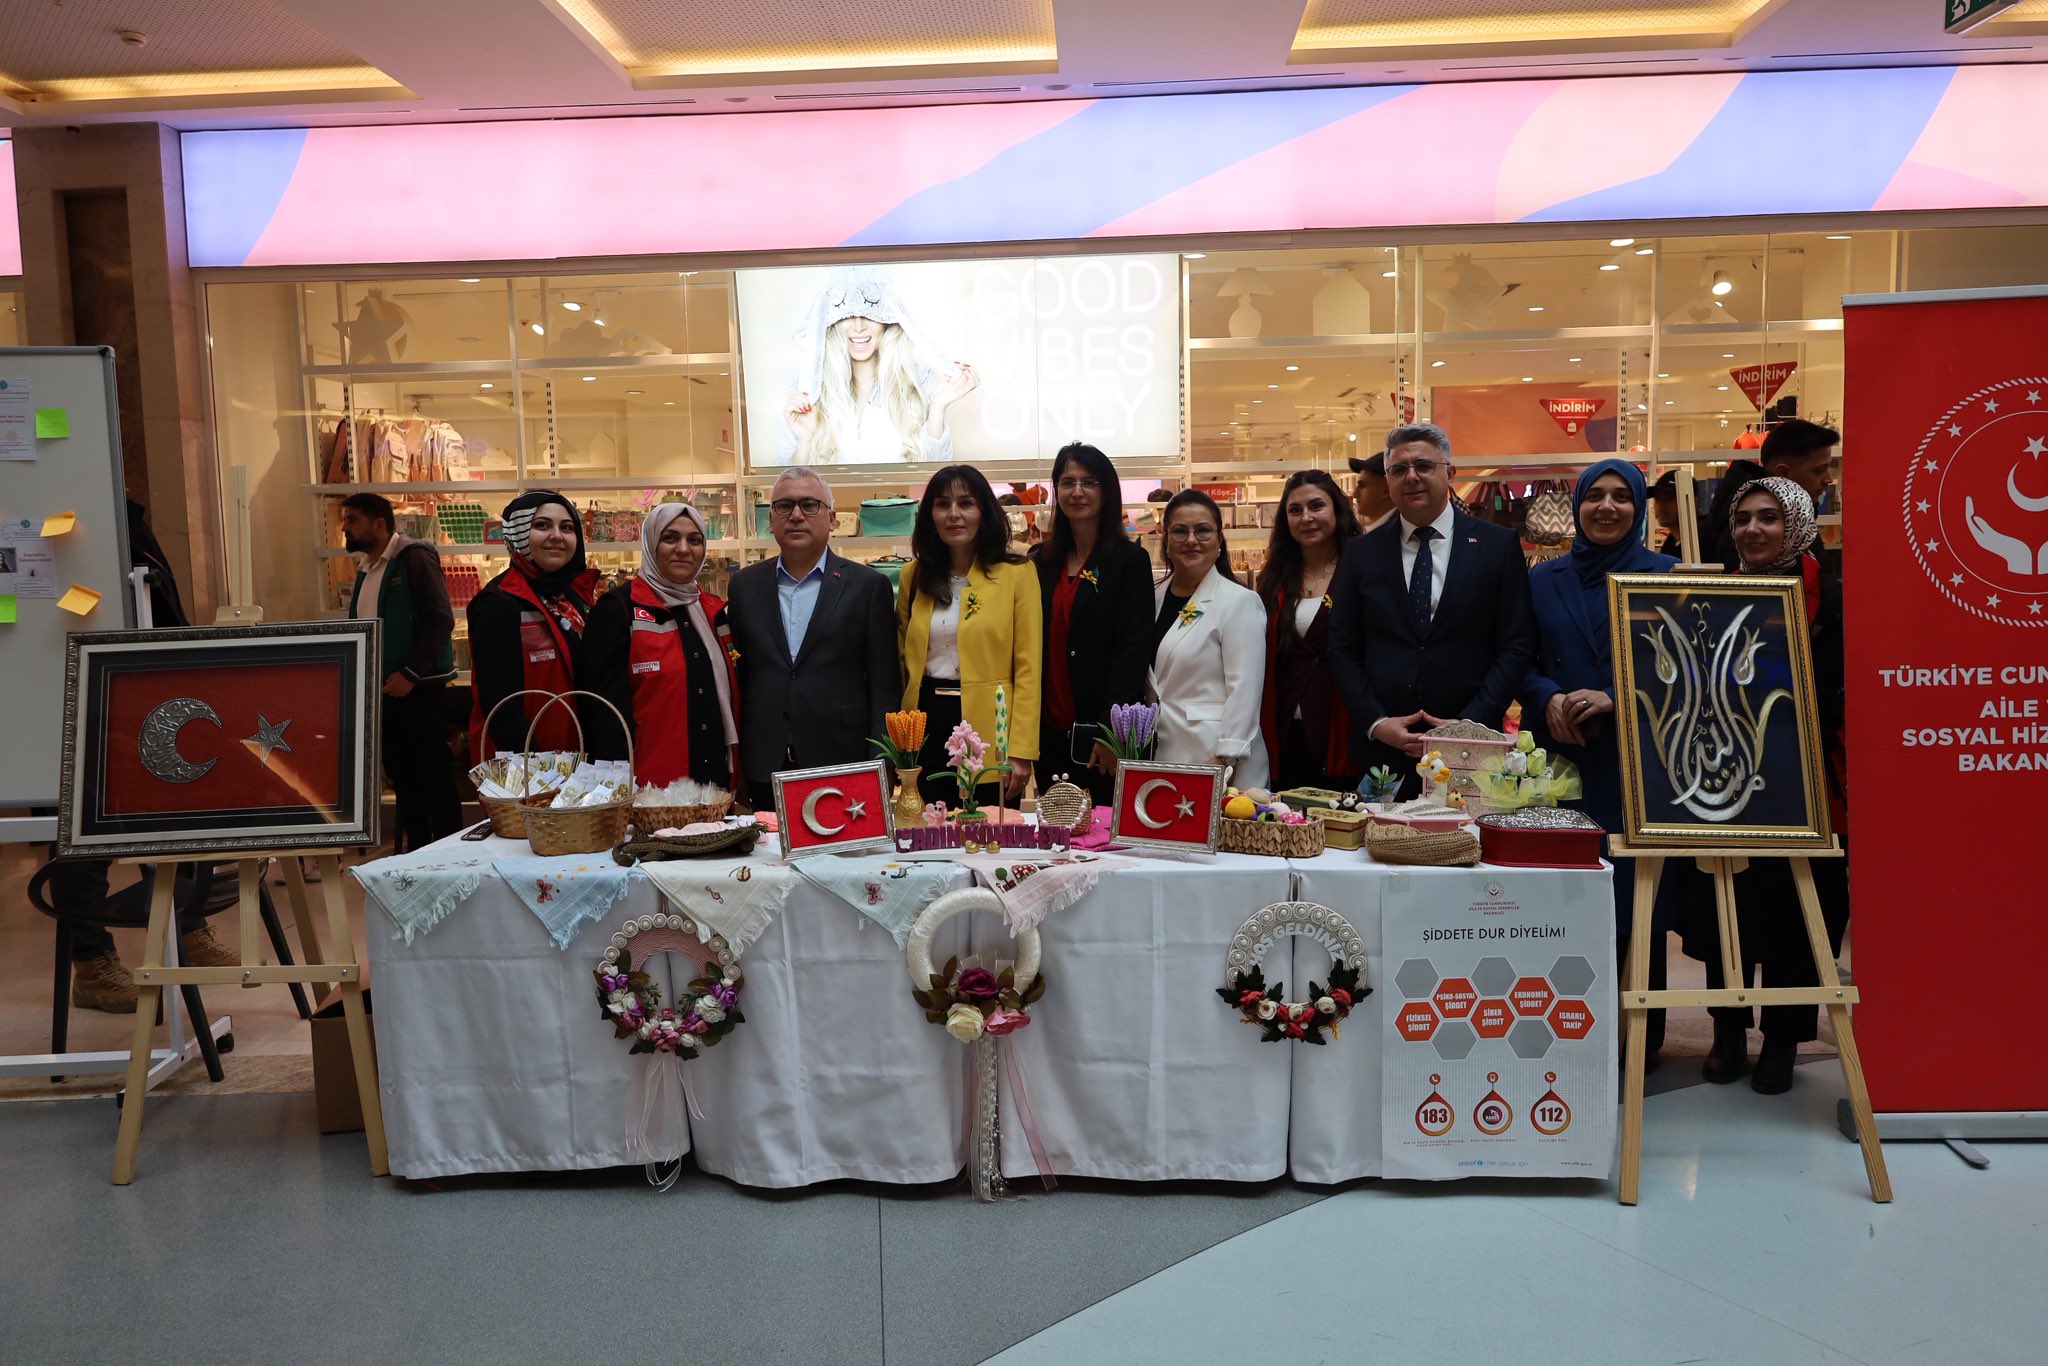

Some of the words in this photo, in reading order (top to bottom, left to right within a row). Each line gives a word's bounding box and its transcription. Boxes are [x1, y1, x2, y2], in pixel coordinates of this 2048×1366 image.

[974, 260, 1163, 321] GOOD
[975, 324, 1156, 379] VIBES
[1738, 366, 1786, 383] İNDRİM
[982, 383, 1151, 440] ONLY
[1549, 401, 1596, 413] İNDİRİM
[1878, 663, 1993, 687] TÜRKİYE
[1979, 695, 2038, 718] AİLE
[1902, 728, 2004, 746] SOSYAL
[1423, 926, 1474, 943] ŞİDDETE
[1479, 928, 1505, 939] DUR
[1510, 924, 1566, 939] DİYELİM!
[1436, 992, 1475, 1000] PSİKO-SOSYAL
[1514, 990, 1548, 998] EKONOMİK
[1444, 1001, 1467, 1010] ŞİDDET
[1519, 1000, 1542, 1008] ŞİDDET
[1406, 1013, 1432, 1022] FİZİKSEL
[1483, 1008, 1502, 1017] SİBER
[1559, 1012, 1586, 1020] ISRARLI
[1407, 1023, 1430, 1032] ŞİDDET
[1481, 1018, 1504, 1027] ŞİDDET
[1562, 1020, 1582, 1029] TAKİP
[1421, 1108, 1448, 1123] 183
[1540, 1107, 1563, 1122] 112
